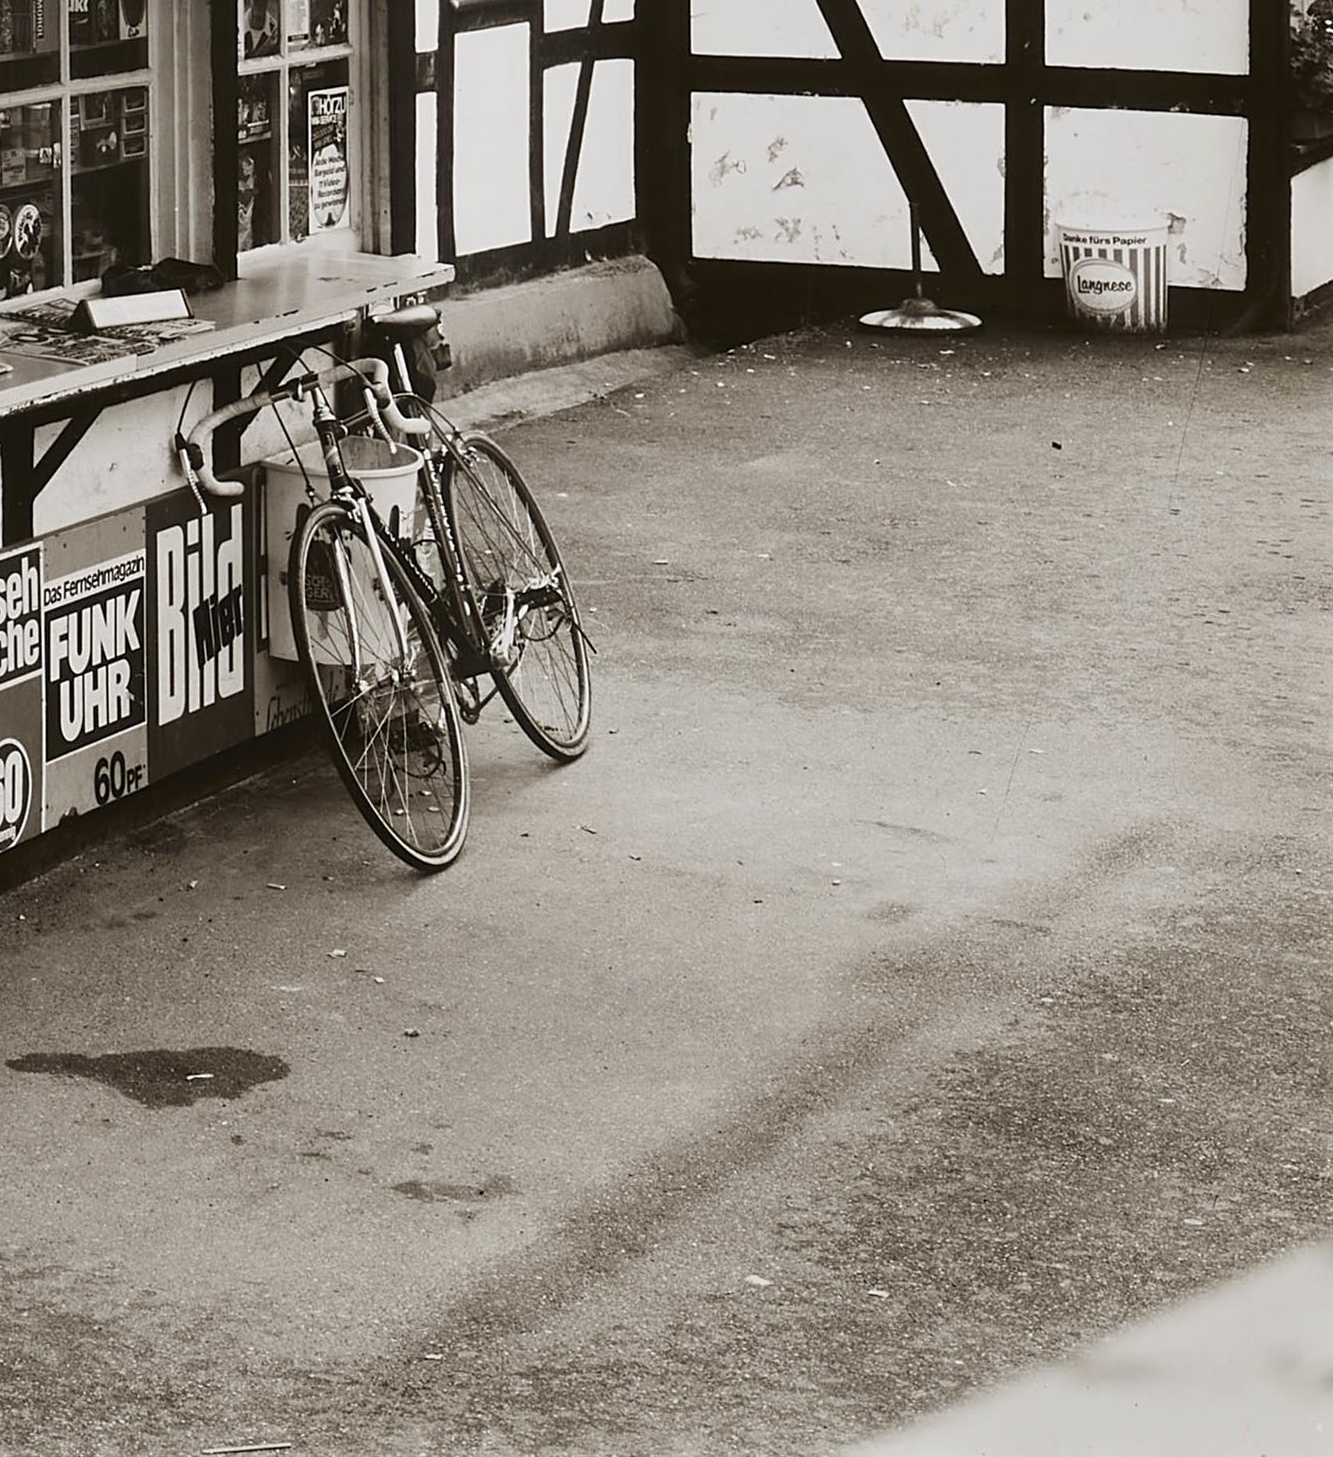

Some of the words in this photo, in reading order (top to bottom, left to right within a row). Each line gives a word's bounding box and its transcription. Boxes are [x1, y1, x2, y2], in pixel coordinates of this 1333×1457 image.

[1063, 233, 1087, 243] Danke
[1089, 236, 1110, 244] fürs
[1112, 236, 1147, 247] Papier
[1077, 275, 1133, 295] Langnese
[44, 585, 62, 607] Das
[63, 554, 145, 598] Fernsehmagazin
[49, 588, 141, 683] FUNK
[157, 503, 244, 727] Bild
[60, 658, 131, 743] UHR
[93, 750, 126, 806] 60
